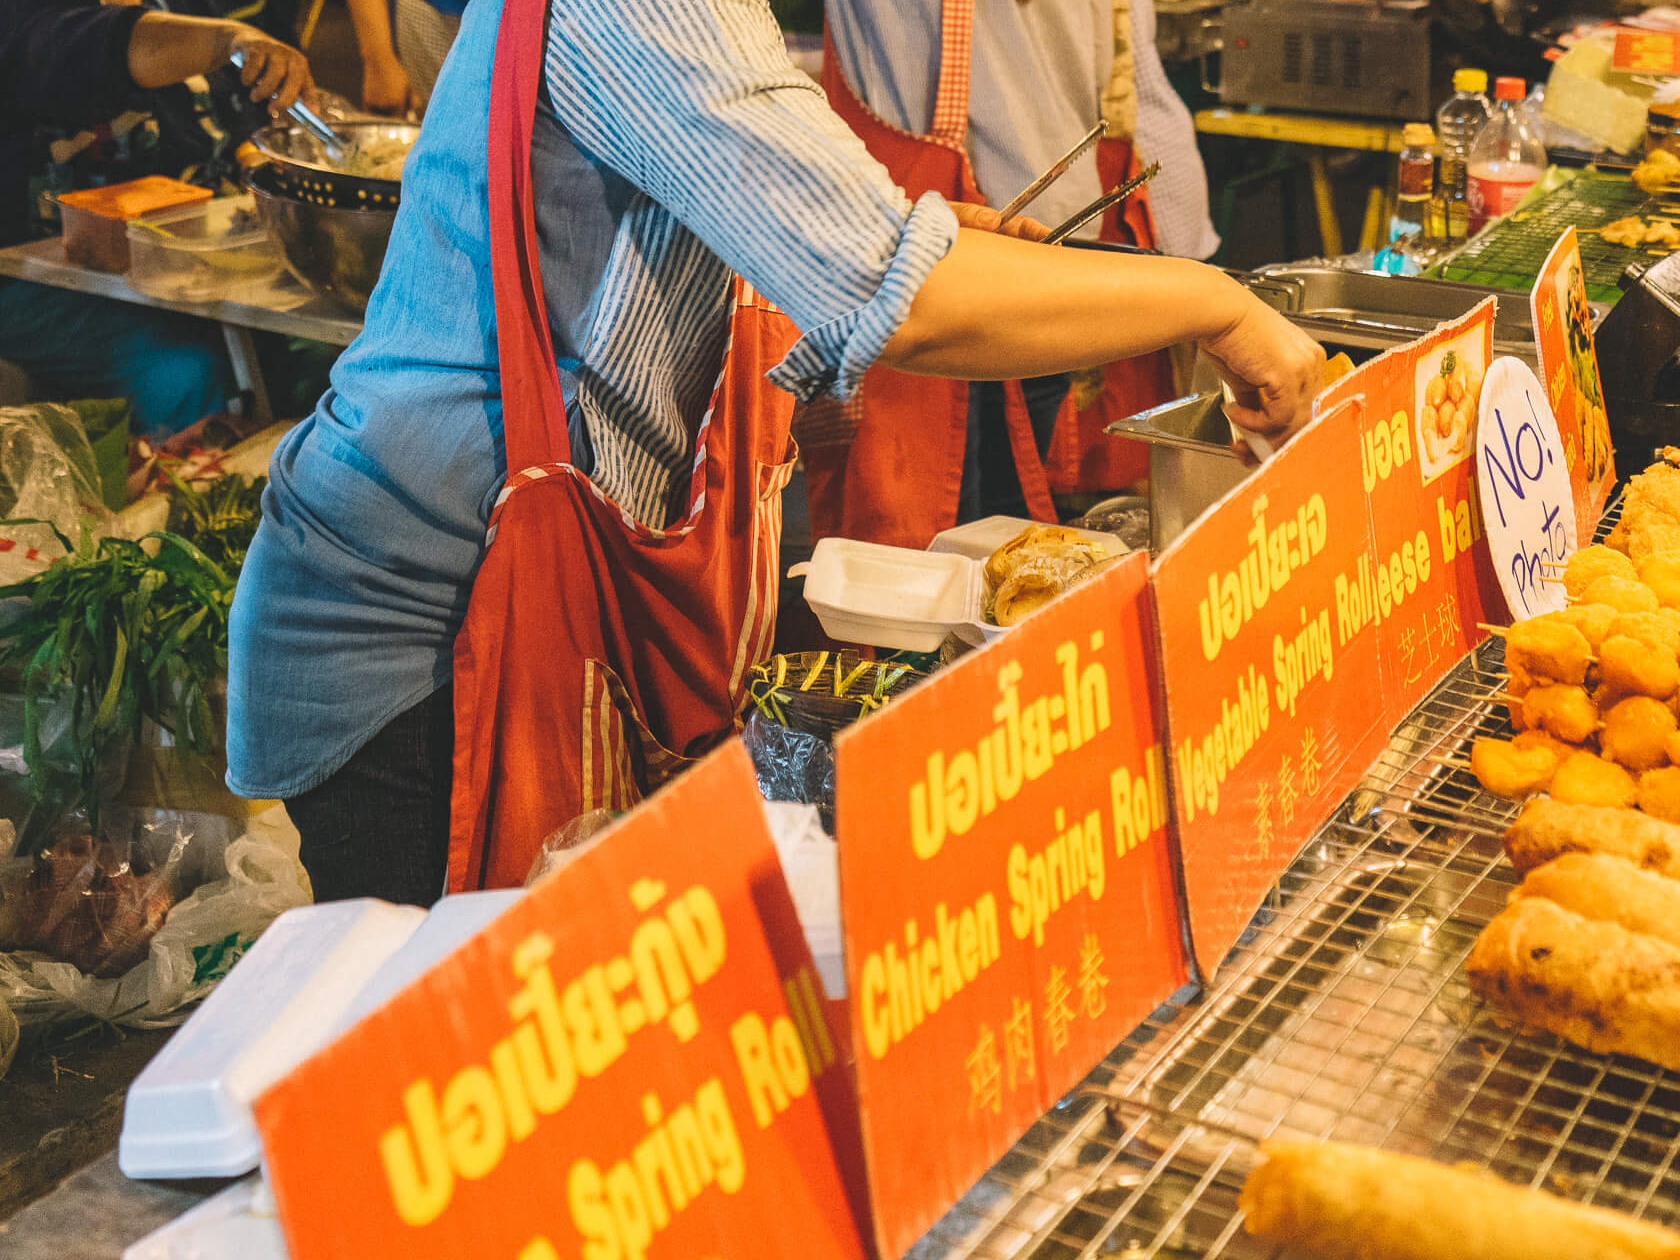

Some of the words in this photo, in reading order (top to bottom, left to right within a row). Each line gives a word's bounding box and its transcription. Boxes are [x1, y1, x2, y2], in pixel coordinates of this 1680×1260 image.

[1178, 663, 1271, 823] Vegetable
[1273, 607, 1334, 718] Spring
[1335, 551, 1373, 648] Roll
[1371, 530, 1431, 627] eese
[1437, 476, 1480, 564] bal
[860, 890, 1001, 1060] Chicken
[1007, 806, 1106, 947] Spring
[1109, 744, 1168, 859] Roll
[566, 1078, 745, 1260] Spring
[730, 967, 835, 1129] Roll
